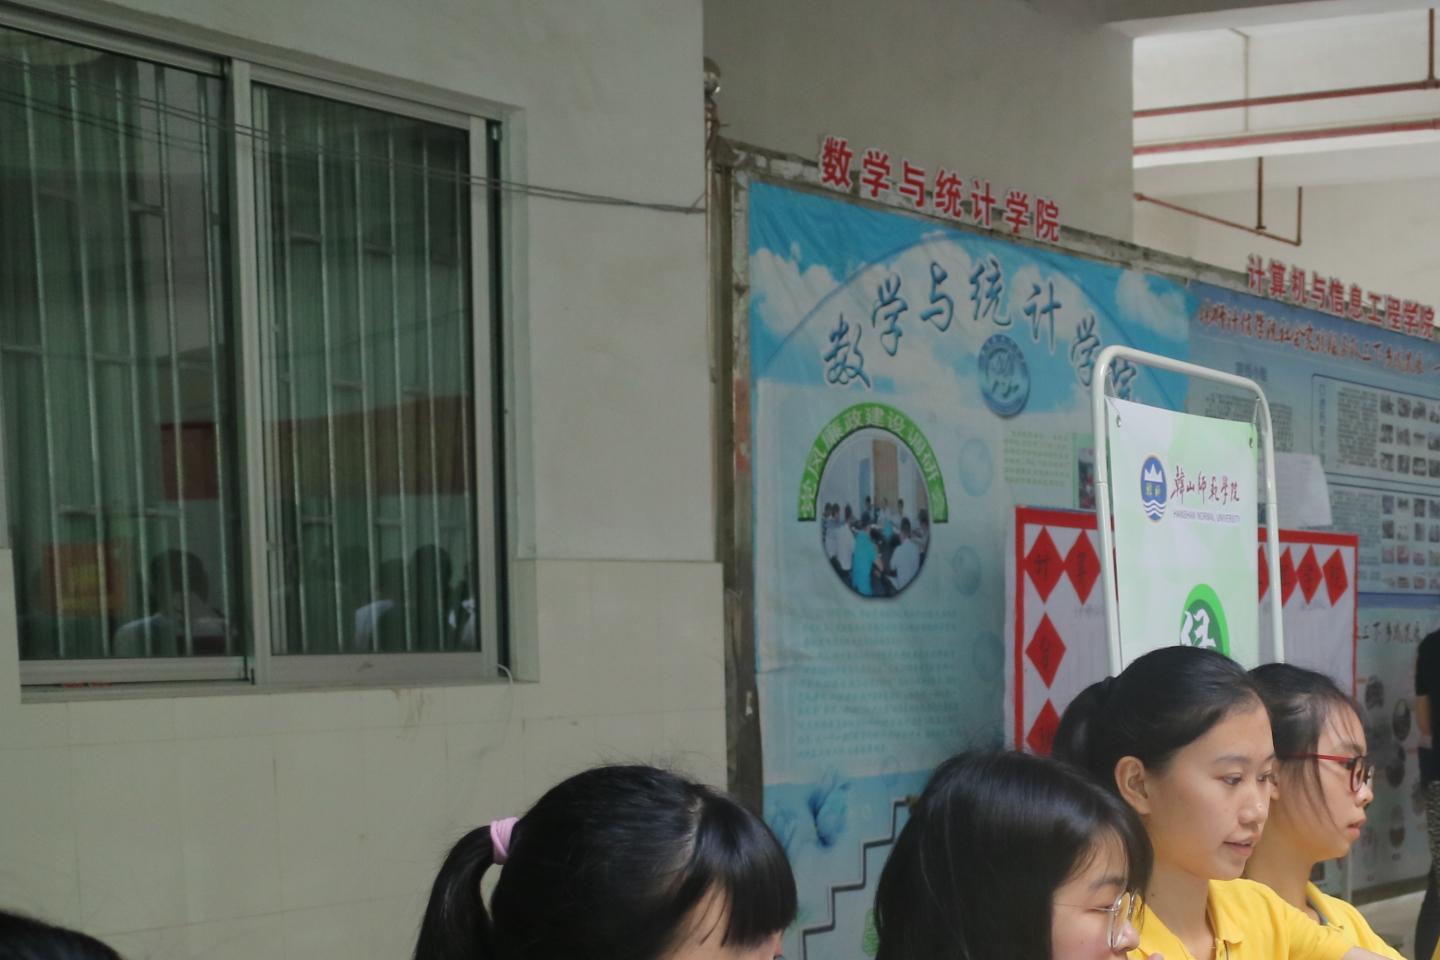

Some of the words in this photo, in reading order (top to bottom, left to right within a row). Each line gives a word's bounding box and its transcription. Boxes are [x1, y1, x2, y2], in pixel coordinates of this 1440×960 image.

[820, 136, 1060, 242] 数学与统计学院
[1247, 253, 1436, 338] 计算机与信息工程学院
